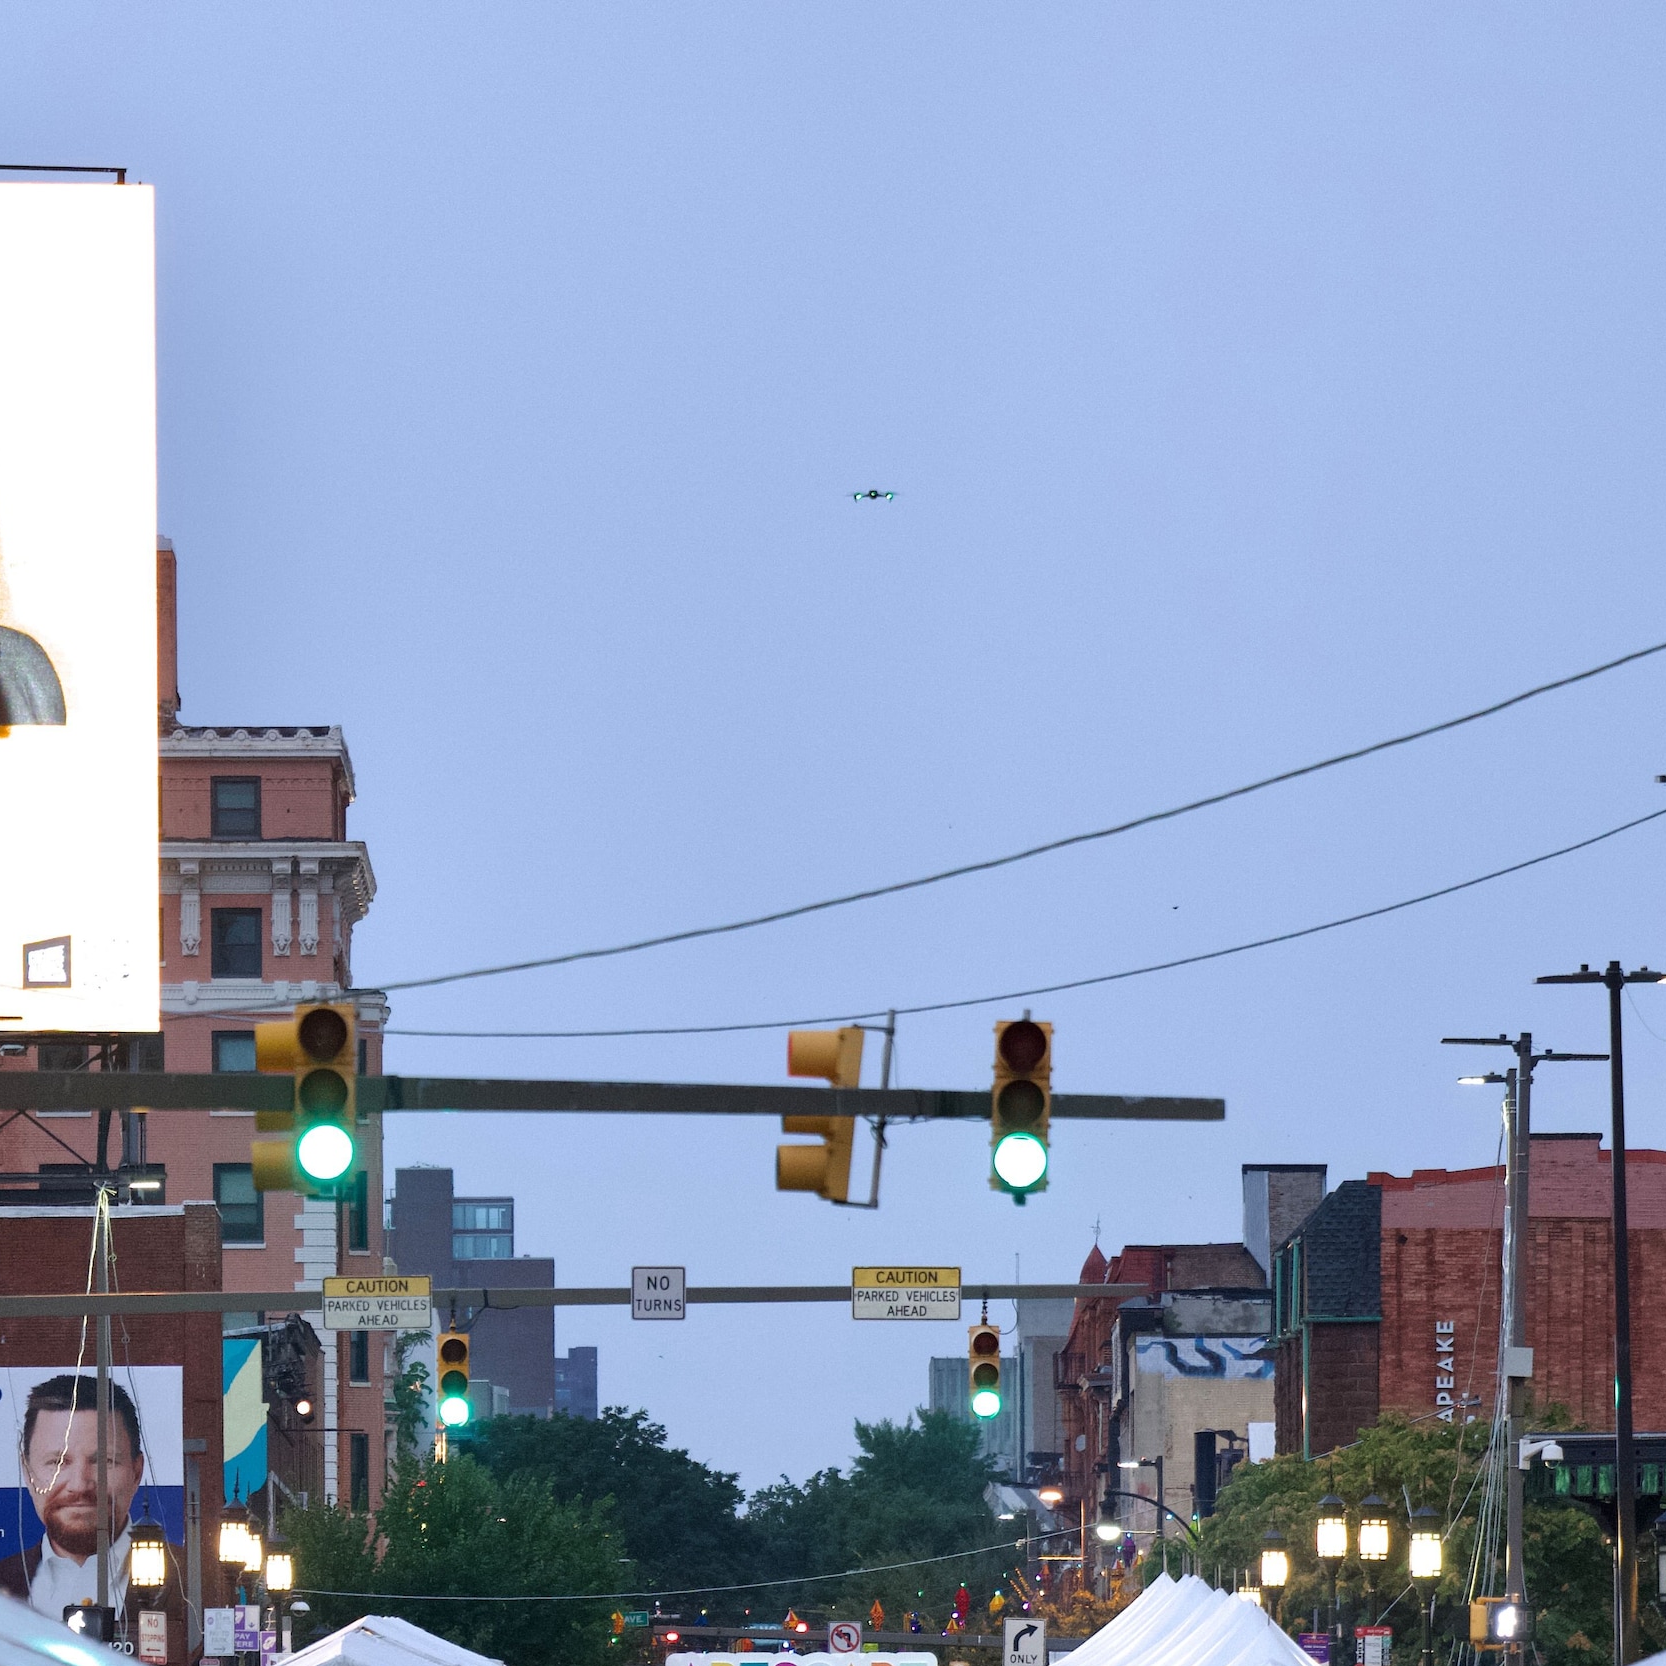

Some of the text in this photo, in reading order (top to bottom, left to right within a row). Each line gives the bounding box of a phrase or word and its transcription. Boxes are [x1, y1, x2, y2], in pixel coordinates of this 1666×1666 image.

[646, 1276, 670, 1291] NO
[876, 1271, 939, 1284] CAUTION
[346, 1280, 409, 1293] CAUTION
[857, 1290, 957, 1303] PARKED VEHICLES
[328, 1299, 427, 1312] PARKED VEHICLES
[635, 1298, 682, 1312] TURNS
[887, 1305, 928, 1317] AHEAD
[358, 1315, 399, 1326] AHEAD
[1436, 1320, 1454, 1424] APEAKE
[147, 1618, 159, 1628] NO
[1010, 1654, 1038, 1665] ONLY
